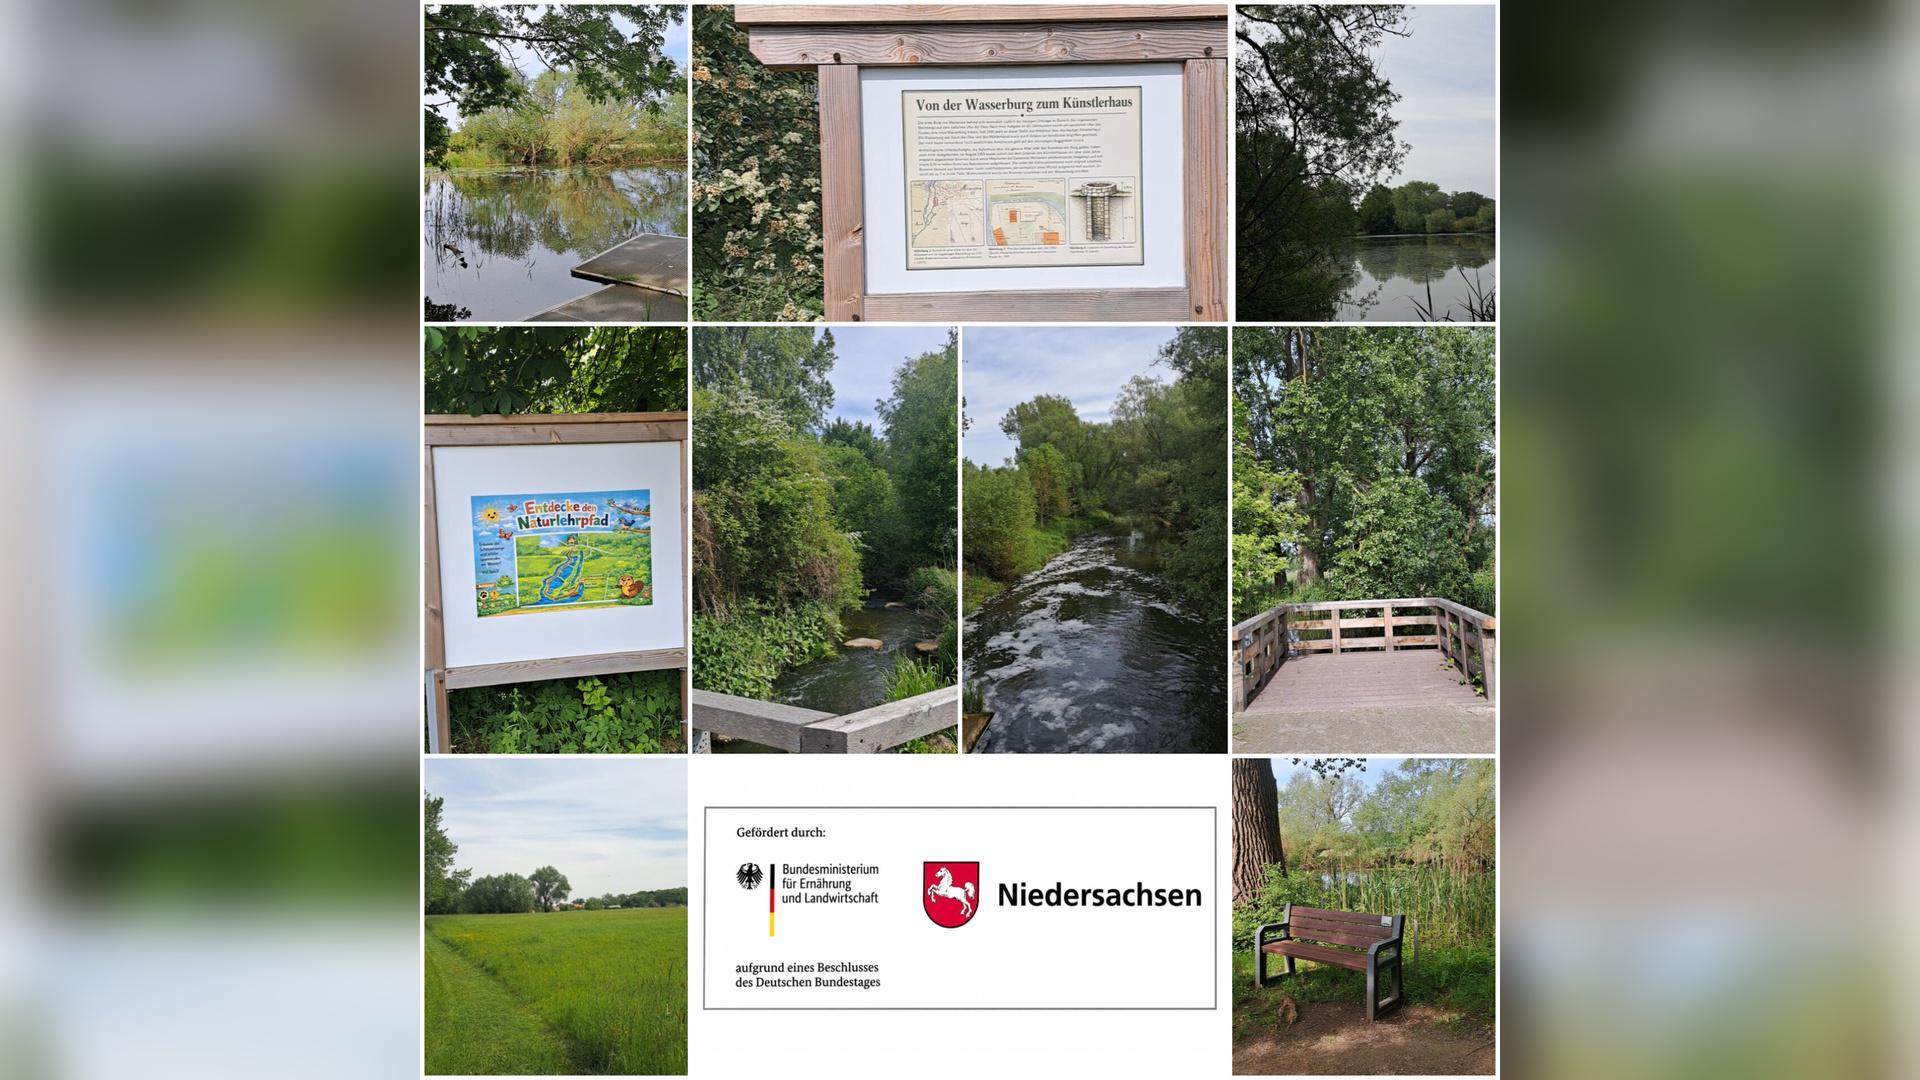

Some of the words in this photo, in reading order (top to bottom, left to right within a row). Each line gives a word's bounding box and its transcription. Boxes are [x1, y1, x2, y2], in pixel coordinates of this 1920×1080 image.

[916, 99, 940, 111] Von
[943, 99, 962, 111] der
[965, 98, 1033, 113] Wasserburg
[1036, 101, 1059, 109] zum
[1063, 96, 1133, 109] Künstlerhaus
[525, 501, 580, 514] Entdecke
[582, 504, 597, 512] den
[517, 514, 609, 530] Naturlehrpfad
